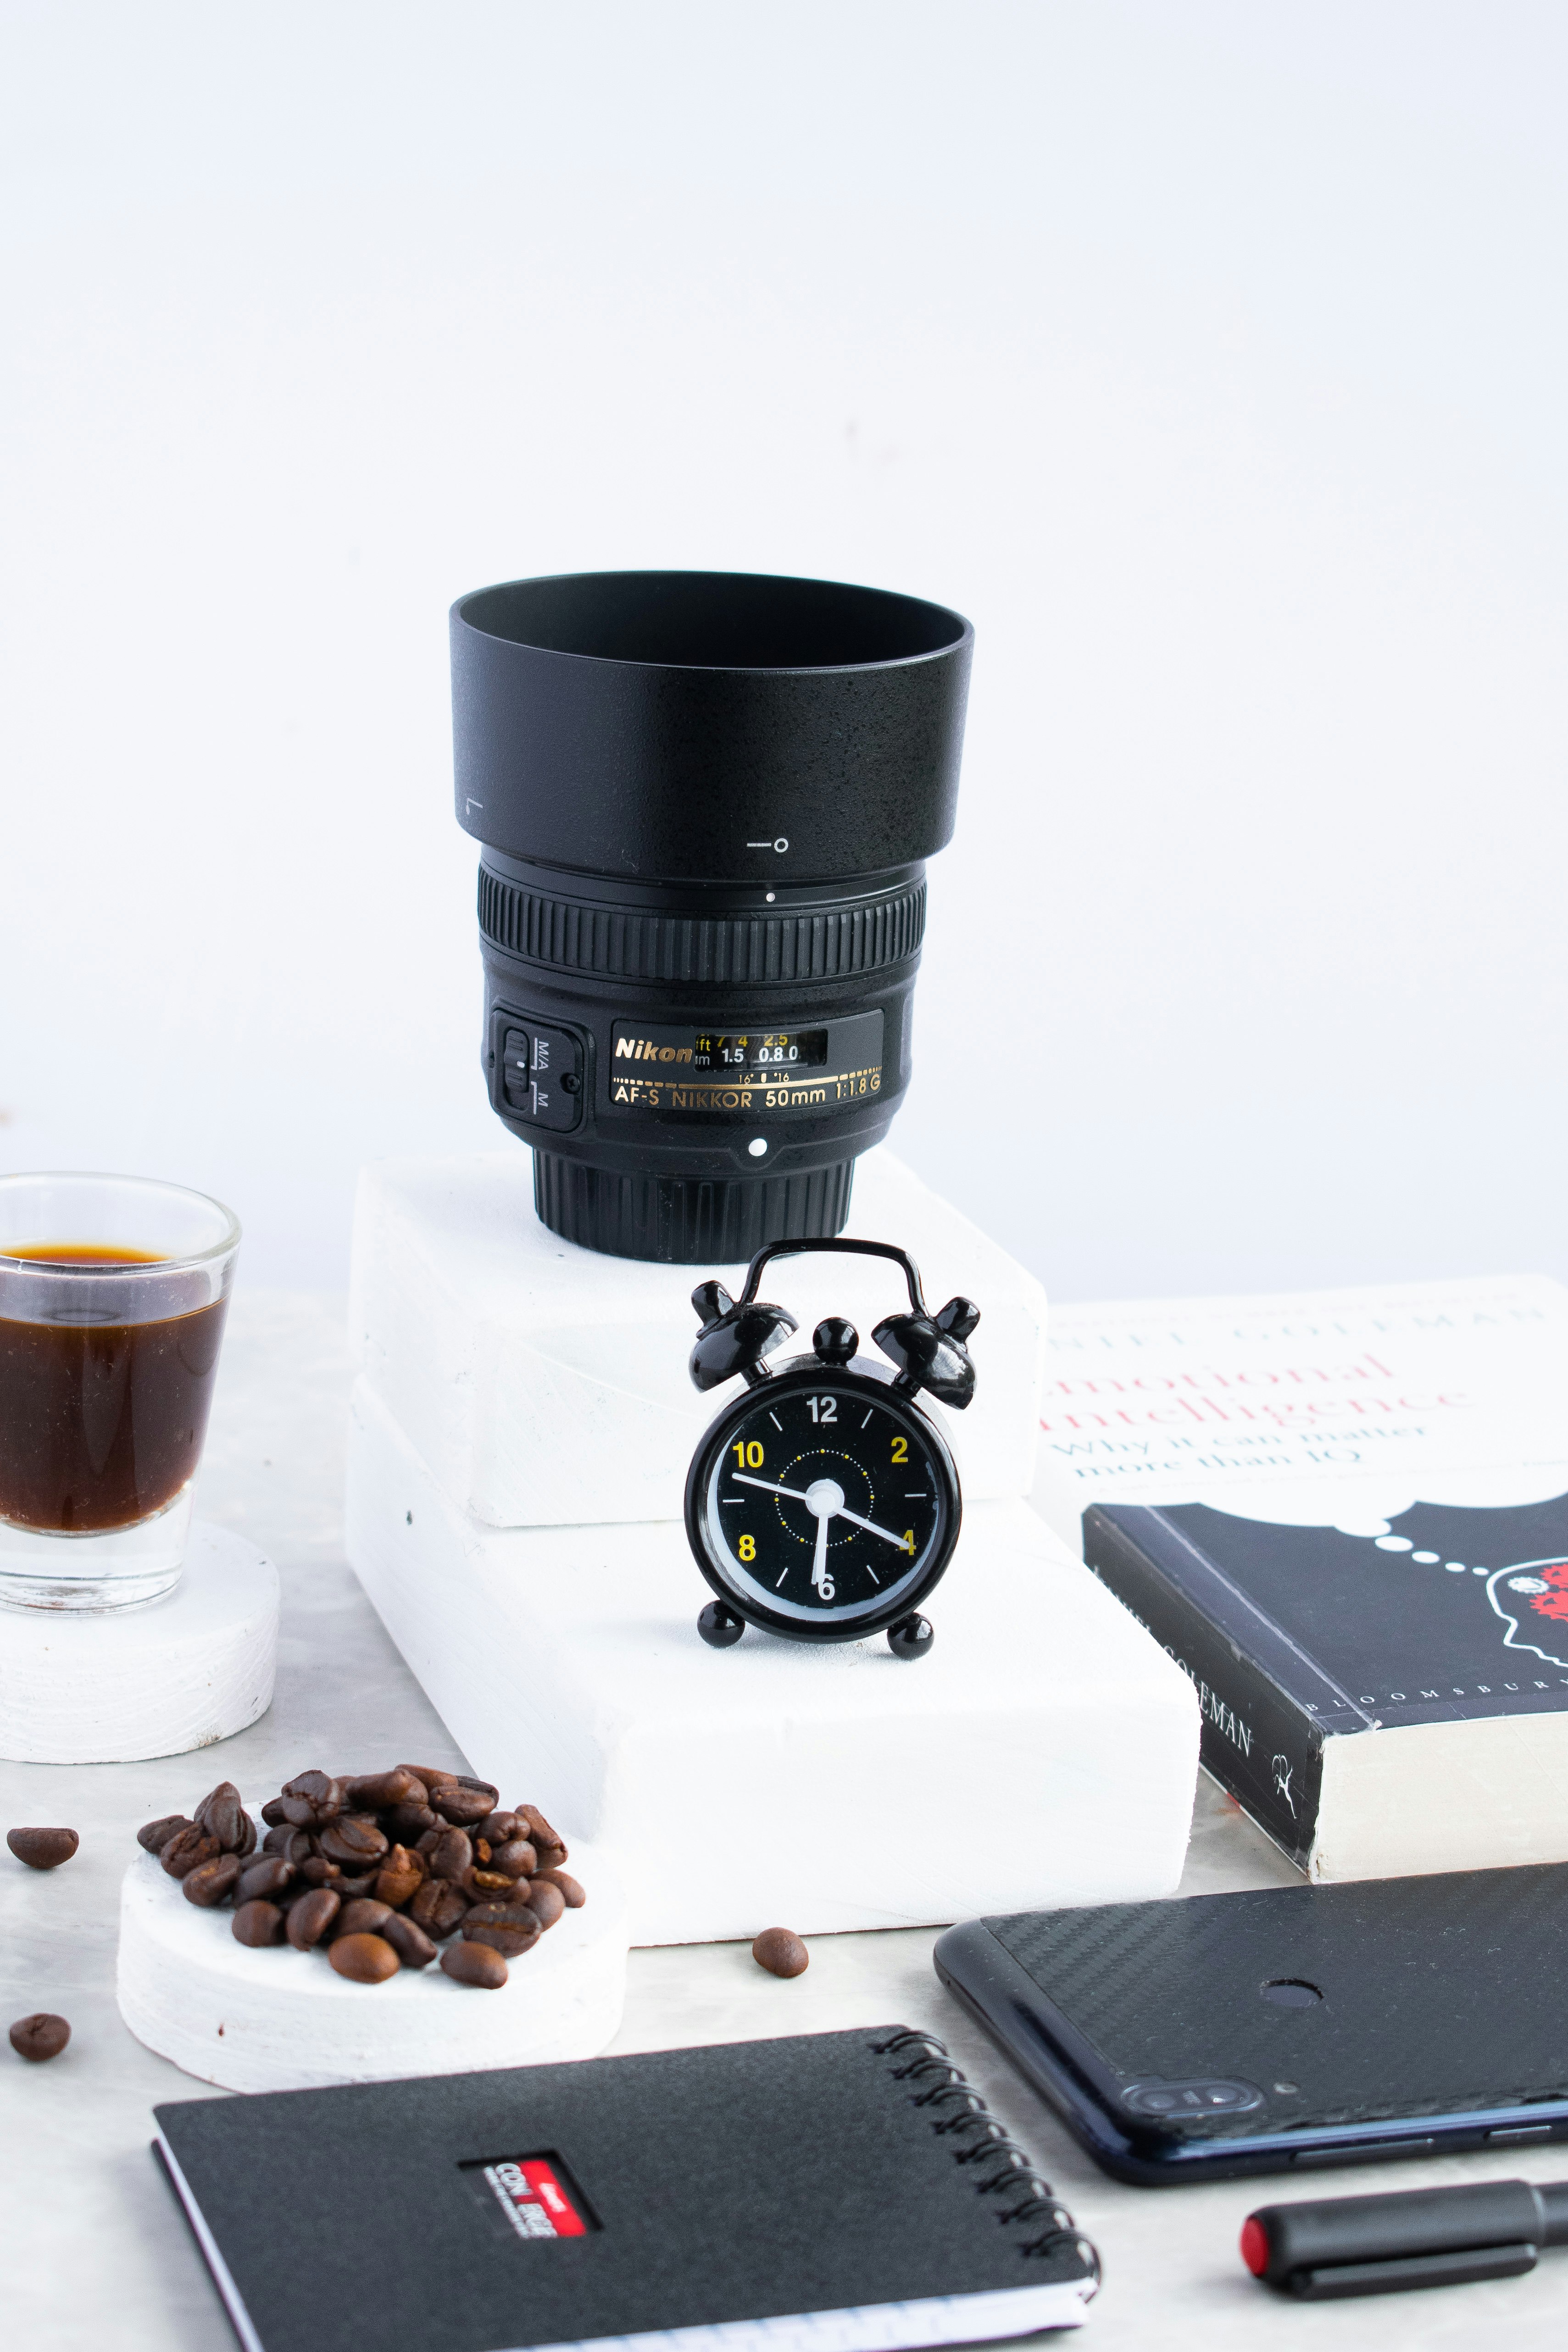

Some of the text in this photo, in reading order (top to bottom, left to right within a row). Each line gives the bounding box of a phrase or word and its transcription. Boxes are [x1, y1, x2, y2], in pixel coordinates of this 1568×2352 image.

[615, 1038, 693, 1063] Nikon
[738, 1035, 748, 1047] 4
[764, 1035, 788, 1047] 2.5
[538, 1041, 550, 1070] M/A
[722, 1048, 744, 1063] 1.5
[758, 1046, 784, 1062] 0.8
[538, 1092, 549, 1107] M
[615, 1085, 659, 1105] AF-S
[672, 1090, 751, 1108] NIKKOR
[765, 1088, 826, 1106] 50mm
[1042, 1352, 1398, 1396] motional
[806, 1396, 838, 1423] 12
[891, 1437, 908, 1463] 2
[1051, 1425, 1429, 1457] Why it can matter
[733, 1441, 764, 1468] 10
[1073, 1461, 1184, 1479] more
[1197, 1452, 1294, 1468] than
[1307, 1448, 1365, 1464] IQ
[739, 1535, 756, 1561] 8
[899, 1529, 917, 1556] 4
[817, 1574, 835, 1600] 6
